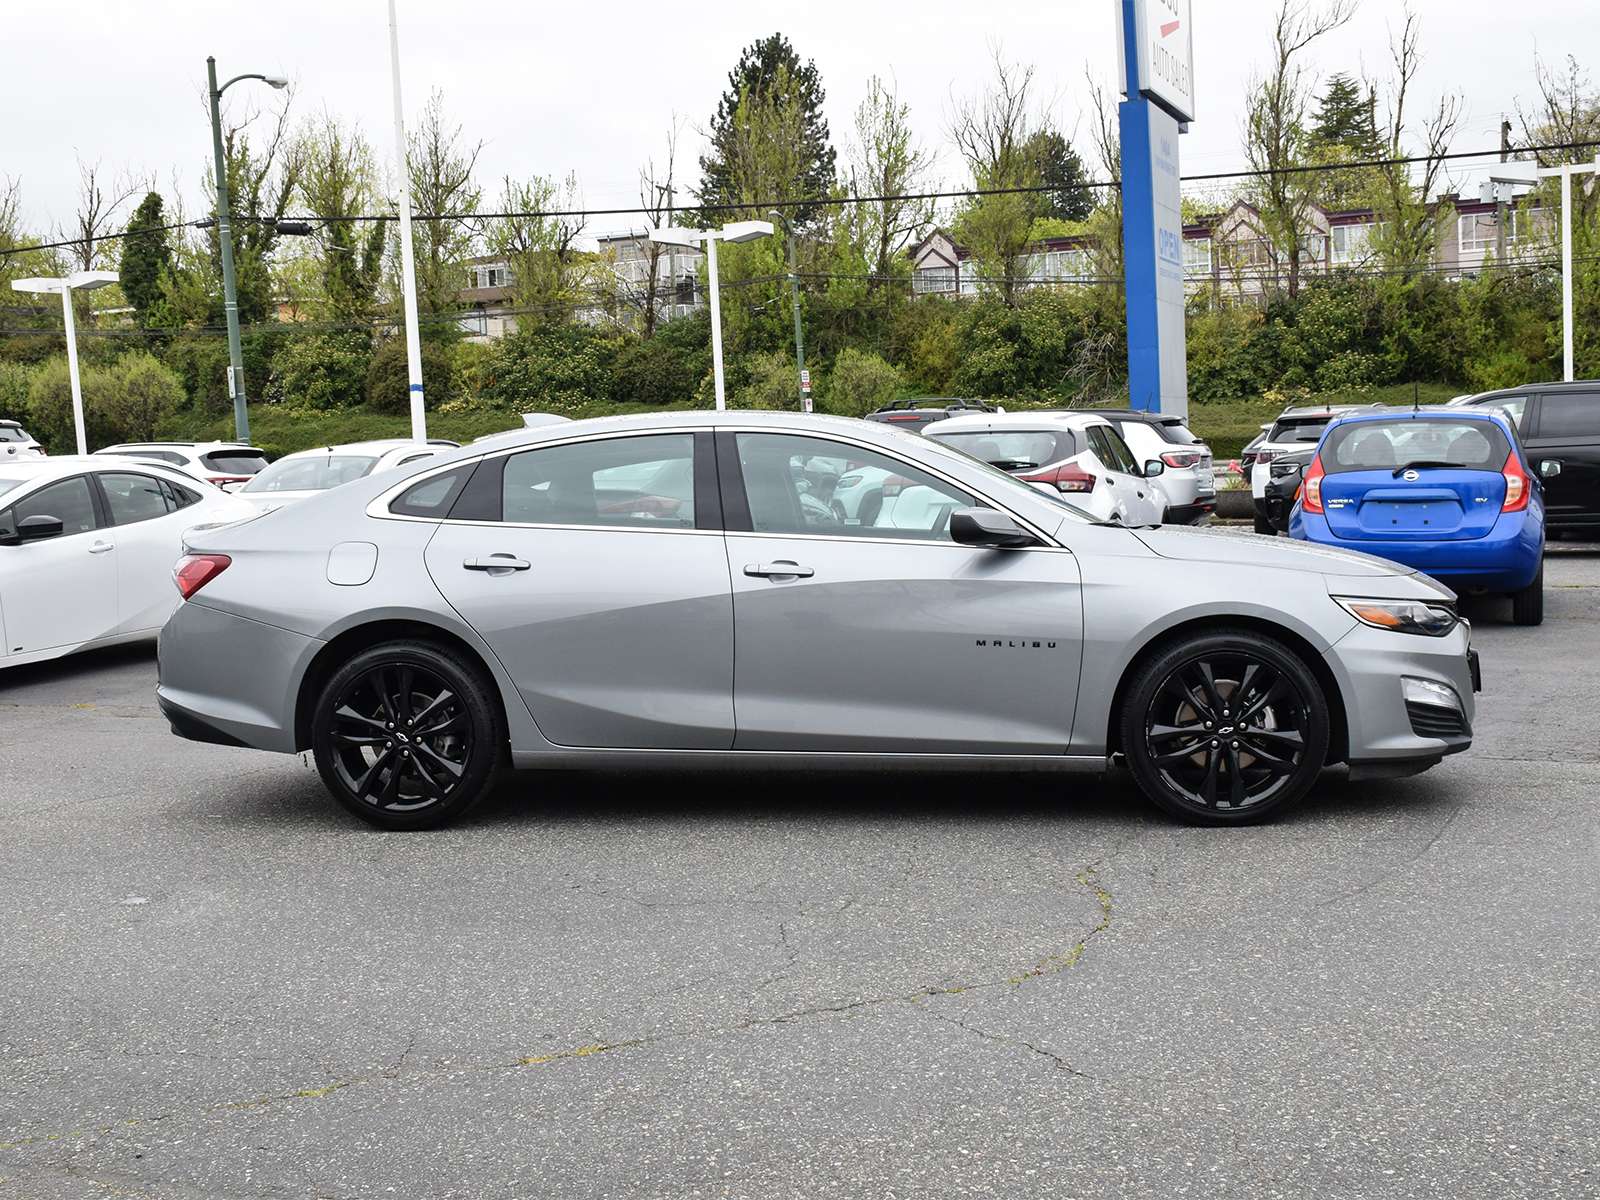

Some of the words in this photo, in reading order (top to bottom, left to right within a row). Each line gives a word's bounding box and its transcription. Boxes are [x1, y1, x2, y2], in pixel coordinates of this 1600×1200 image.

[1152, 41, 1169, 82] AUTO
[1170, 55, 1189, 97] SALES
[1159, 227, 1179, 261] OPEN
[976, 639, 1057, 649] MALIBU
